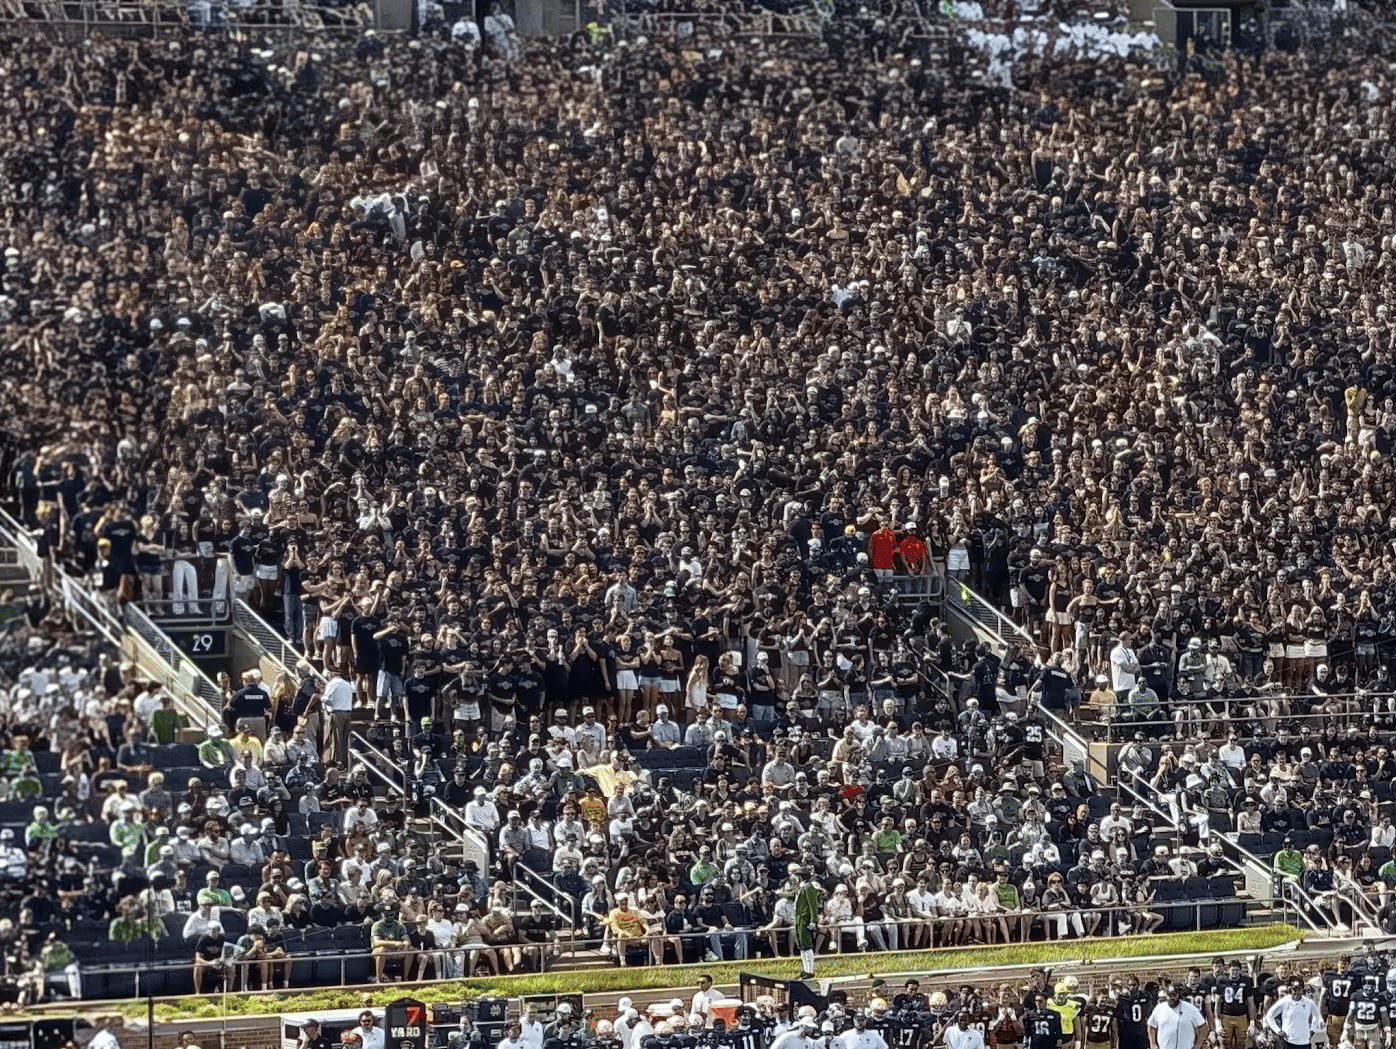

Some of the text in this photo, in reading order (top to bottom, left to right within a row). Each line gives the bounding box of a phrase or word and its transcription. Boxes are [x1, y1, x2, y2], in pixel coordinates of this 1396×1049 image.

[192, 634, 213, 652] 29
[1025, 725, 1042, 742] 25
[1224, 986, 1245, 1004] 84
[1332, 979, 1352, 998] 67
[406, 1006, 420, 1024] 7
[1131, 1004, 1142, 1022] 0
[1357, 1001, 1377, 1020] 22
[390, 1026, 421, 1038] YARD
[1034, 1020, 1050, 1036] 16
[1091, 1014, 1112, 1033] 37
[899, 1028, 914, 1046] 17
